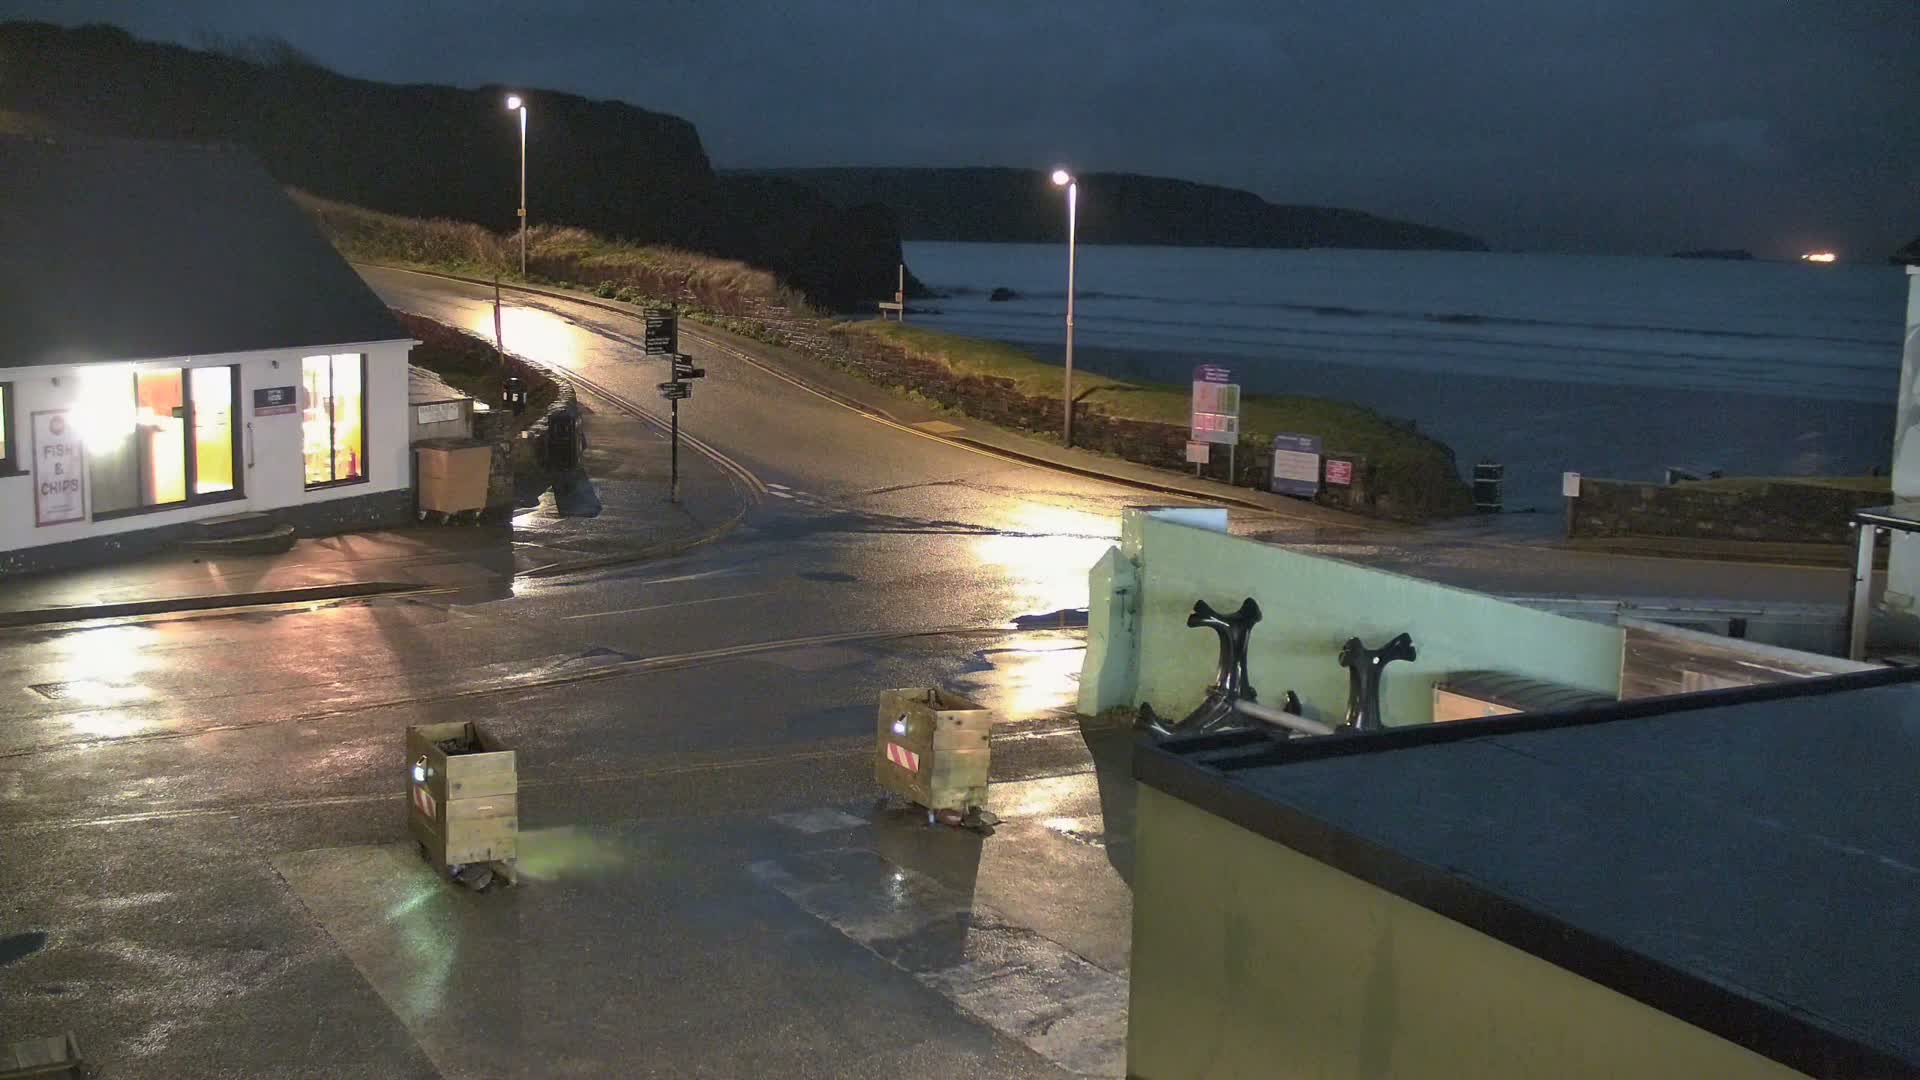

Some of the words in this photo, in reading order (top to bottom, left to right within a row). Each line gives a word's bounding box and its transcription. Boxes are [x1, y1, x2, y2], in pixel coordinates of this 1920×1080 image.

[43, 443, 73, 459] FISH
[55, 462, 64, 475] &
[41, 479, 79, 496] CHIPS
